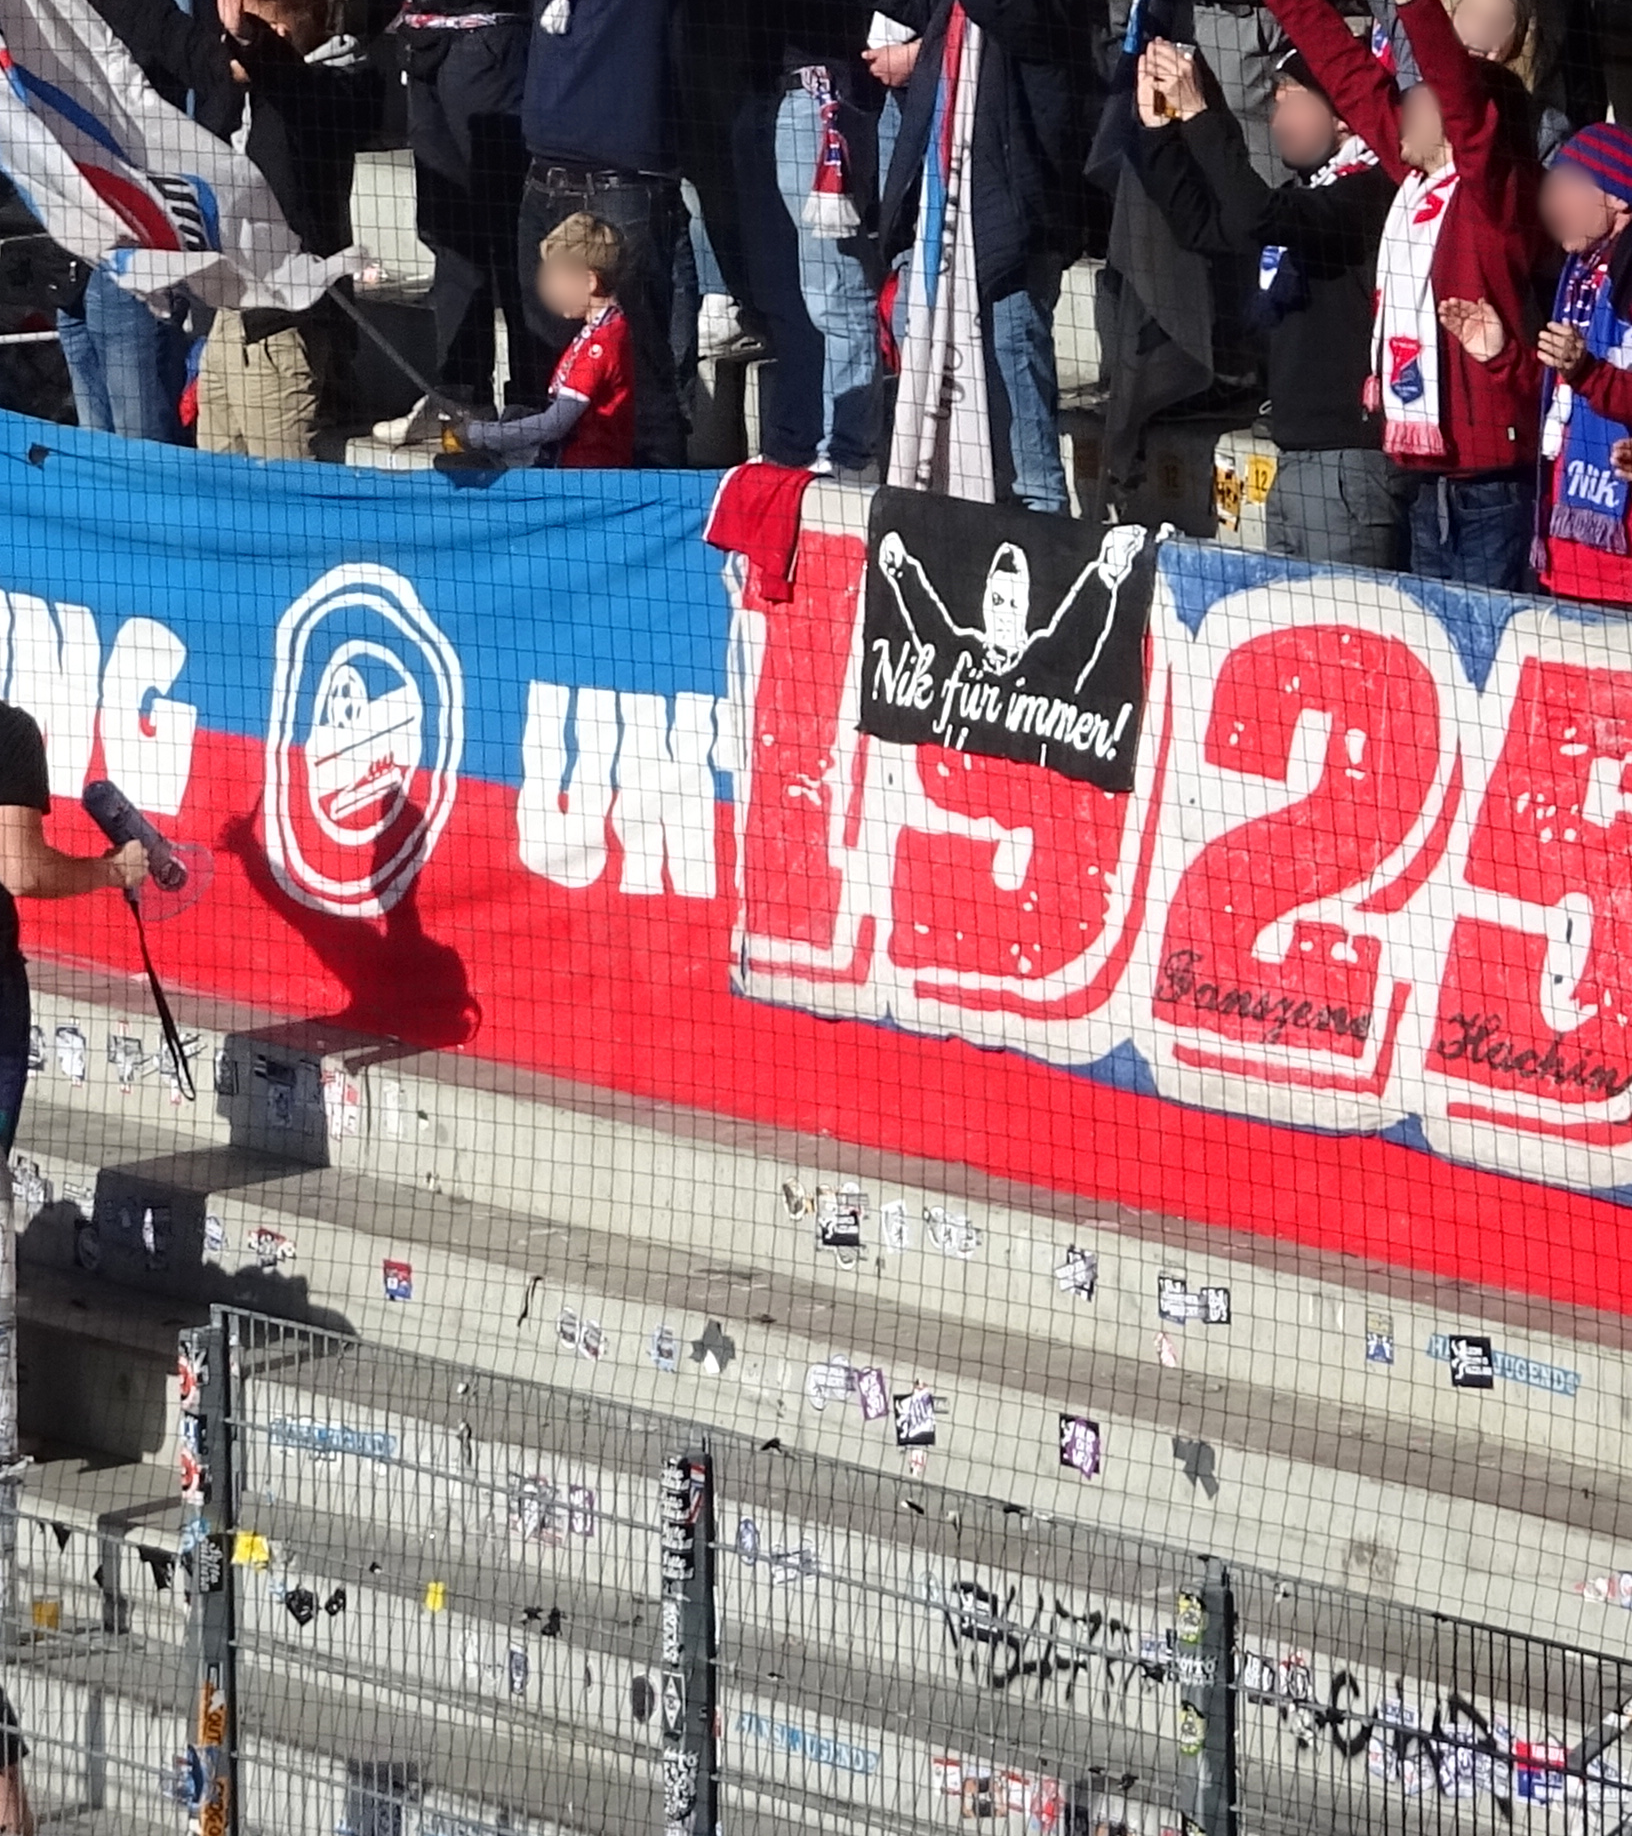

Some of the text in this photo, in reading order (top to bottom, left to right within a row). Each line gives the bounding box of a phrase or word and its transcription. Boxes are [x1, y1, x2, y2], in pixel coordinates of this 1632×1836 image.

[1567, 459, 1621, 509] Nik
[872, 638, 1134, 761] Nik für immer!
